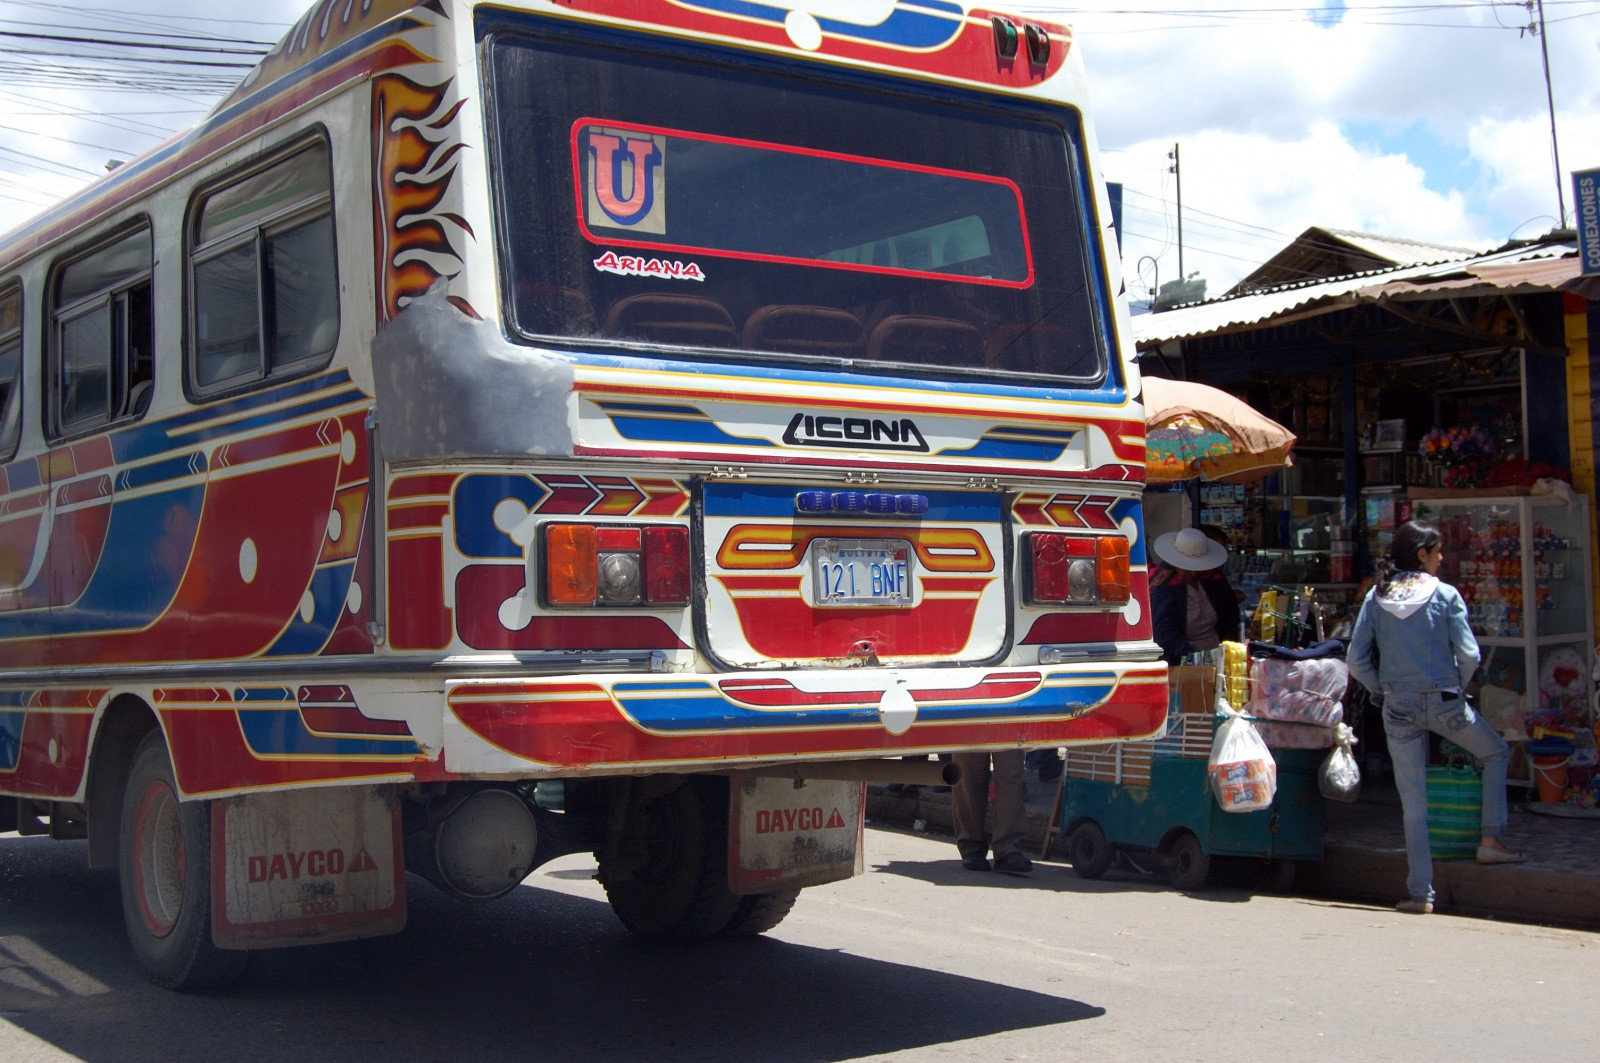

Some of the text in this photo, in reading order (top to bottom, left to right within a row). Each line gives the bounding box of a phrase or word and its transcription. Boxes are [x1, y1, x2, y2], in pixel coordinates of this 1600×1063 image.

[589, 133, 661, 225] U
[1580, 177, 1600, 269] CONEXIONES
[595, 251, 704, 280] ARIANA
[821, 562, 906, 597] 121 BNF
[755, 807, 824, 834] DAYCO
[248, 848, 344, 883] DAYCO
